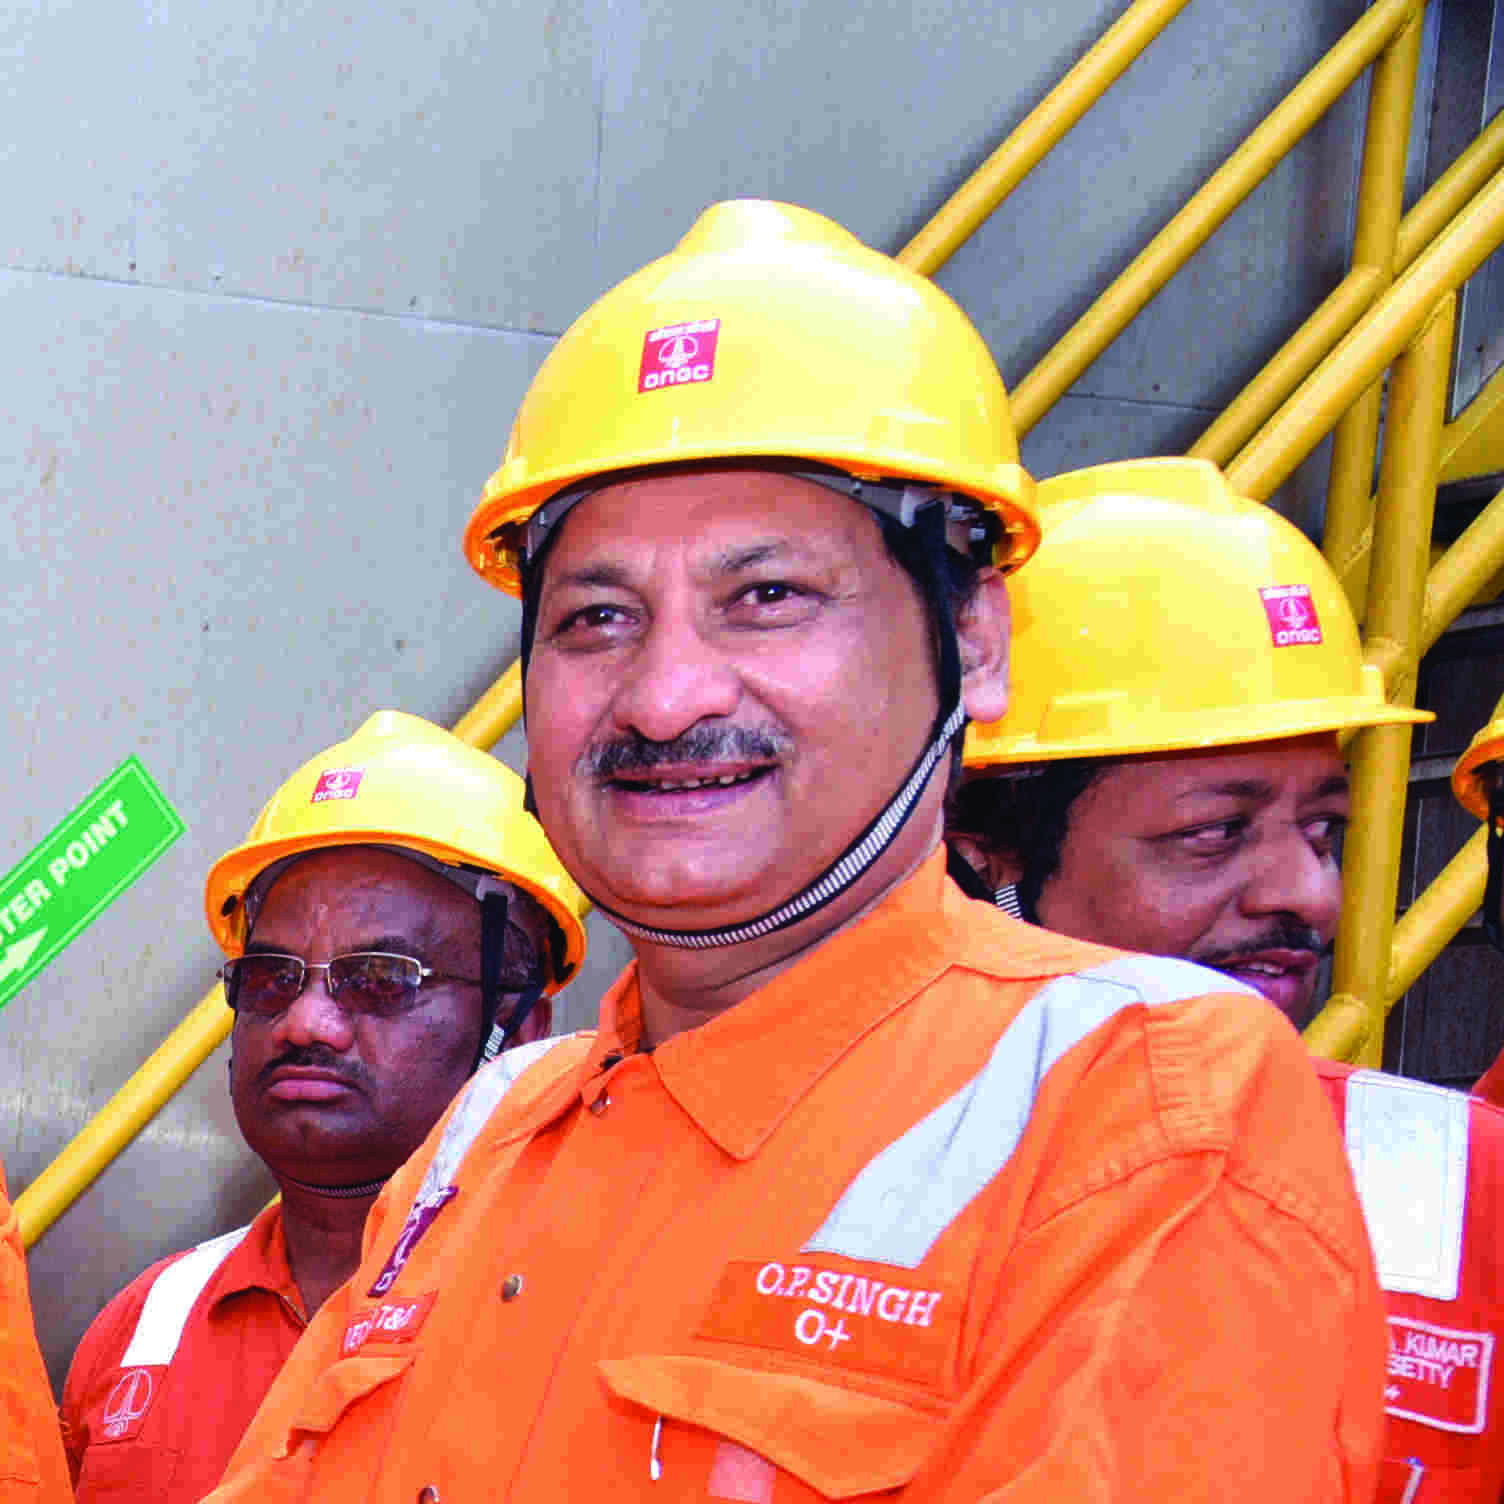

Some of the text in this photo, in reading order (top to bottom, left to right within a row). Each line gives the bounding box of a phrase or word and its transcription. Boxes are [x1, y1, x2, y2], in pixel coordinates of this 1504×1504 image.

[643, 364, 710, 389] ONGC
[47, 799, 128, 886] POINT
[794, 1307, 851, 1351] O+
